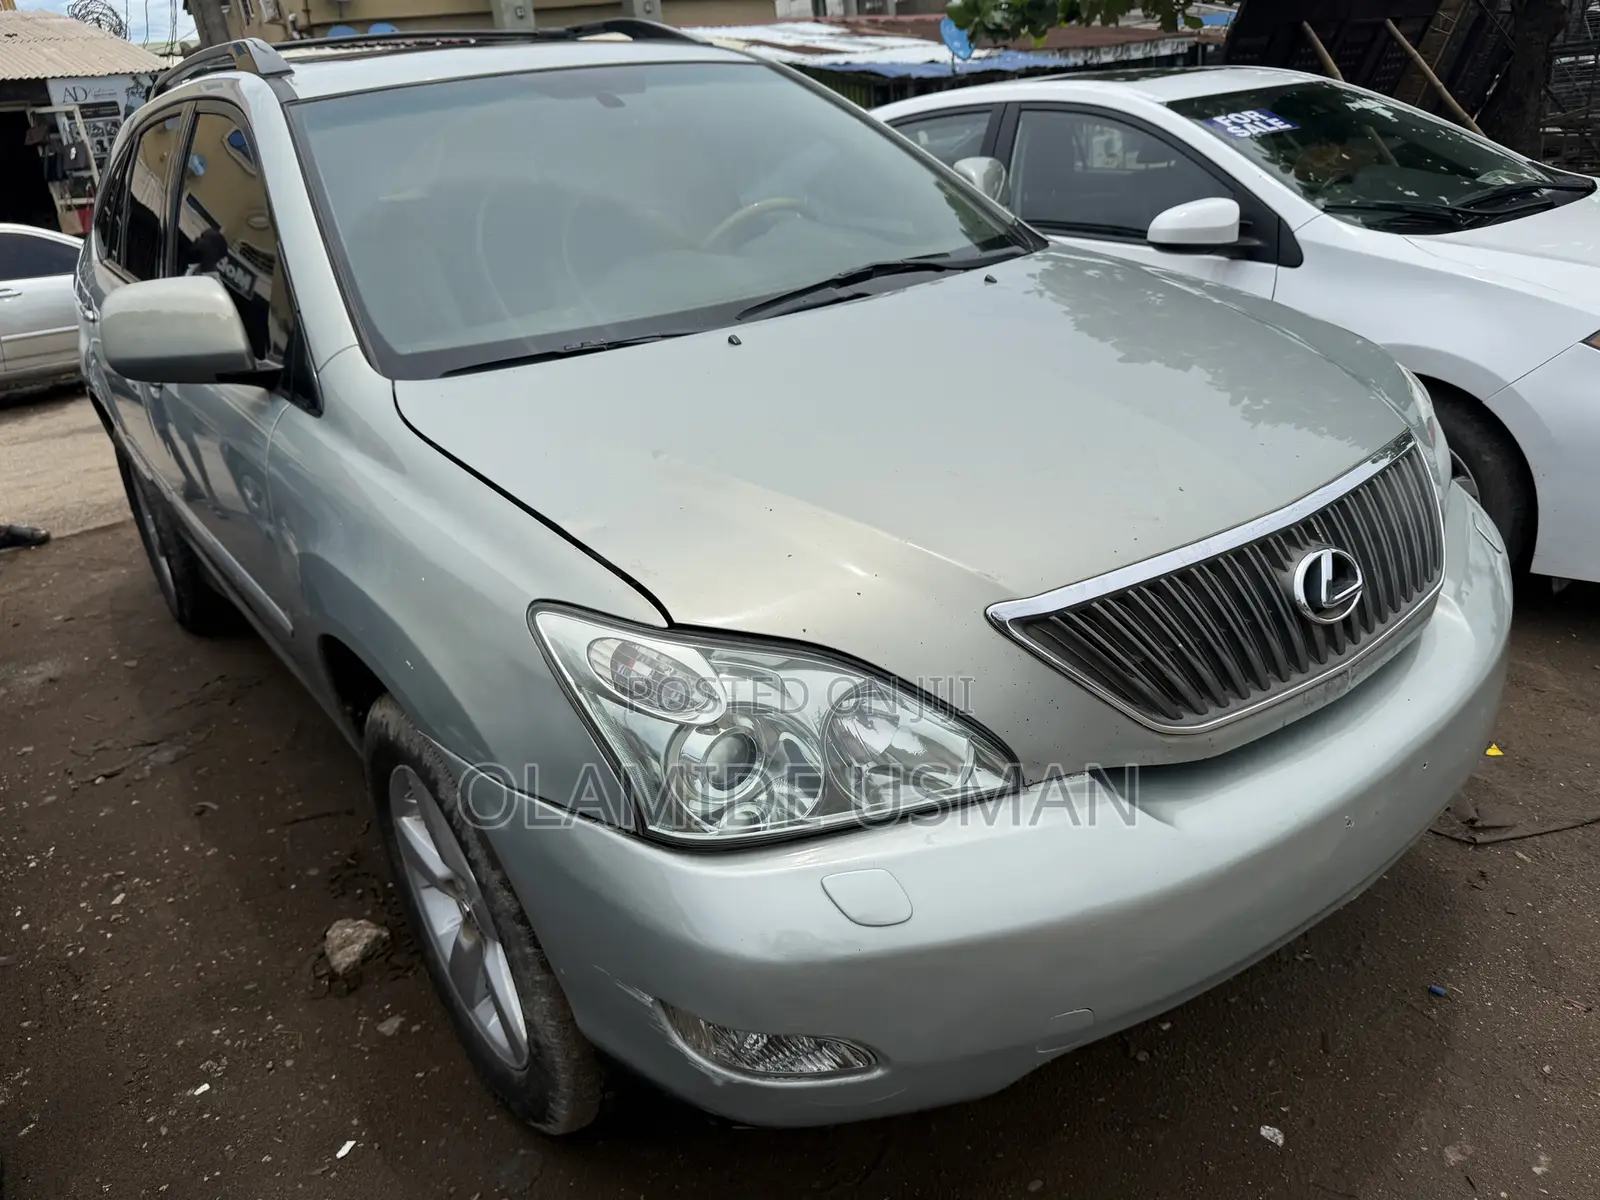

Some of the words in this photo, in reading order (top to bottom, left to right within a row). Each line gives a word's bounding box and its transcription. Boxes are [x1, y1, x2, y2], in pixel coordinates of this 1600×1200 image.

[63, 86, 88, 103] AD
[1213, 110, 1268, 127] FOR
[1227, 118, 1292, 137] SALE
